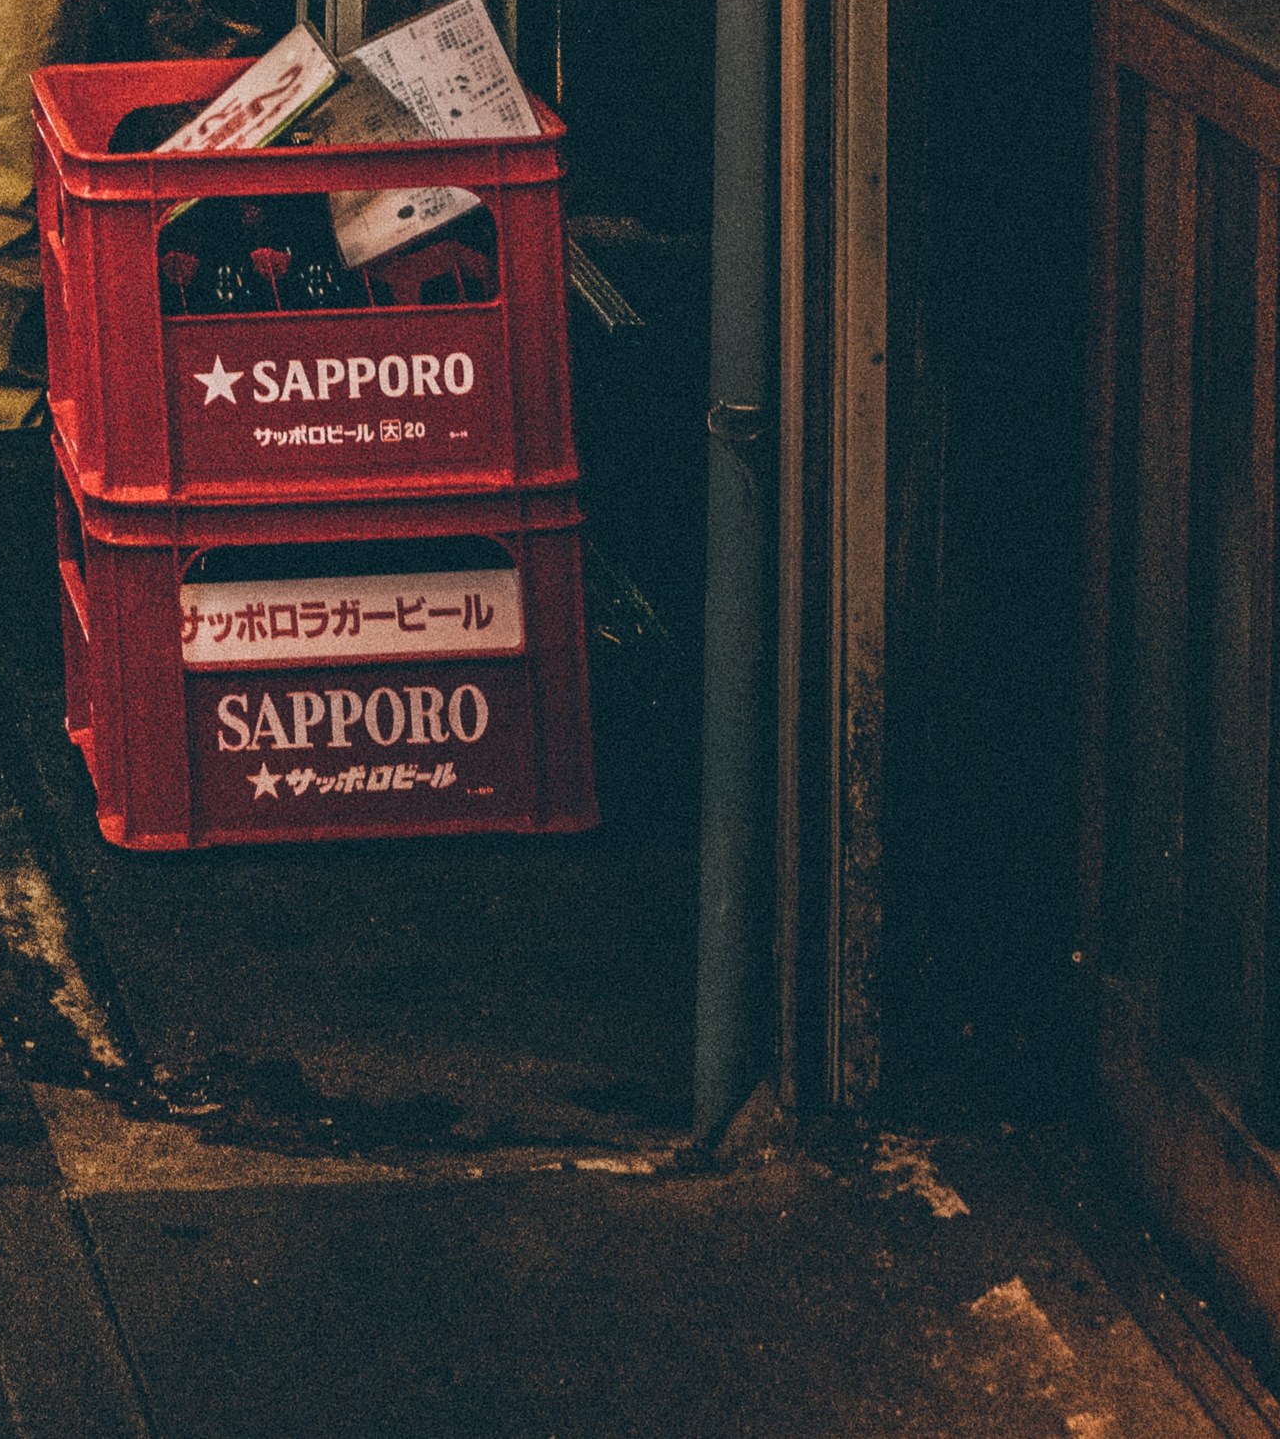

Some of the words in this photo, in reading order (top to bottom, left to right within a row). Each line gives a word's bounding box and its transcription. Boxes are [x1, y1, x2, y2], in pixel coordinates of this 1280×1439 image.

[252, 351, 475, 403] SAPPORO
[252, 422, 376, 447] サッポロビール
[181, 592, 494, 645] サッポロラガービール
[217, 683, 490, 753] SAPPORO
[285, 761, 457, 796] サッポロビール
